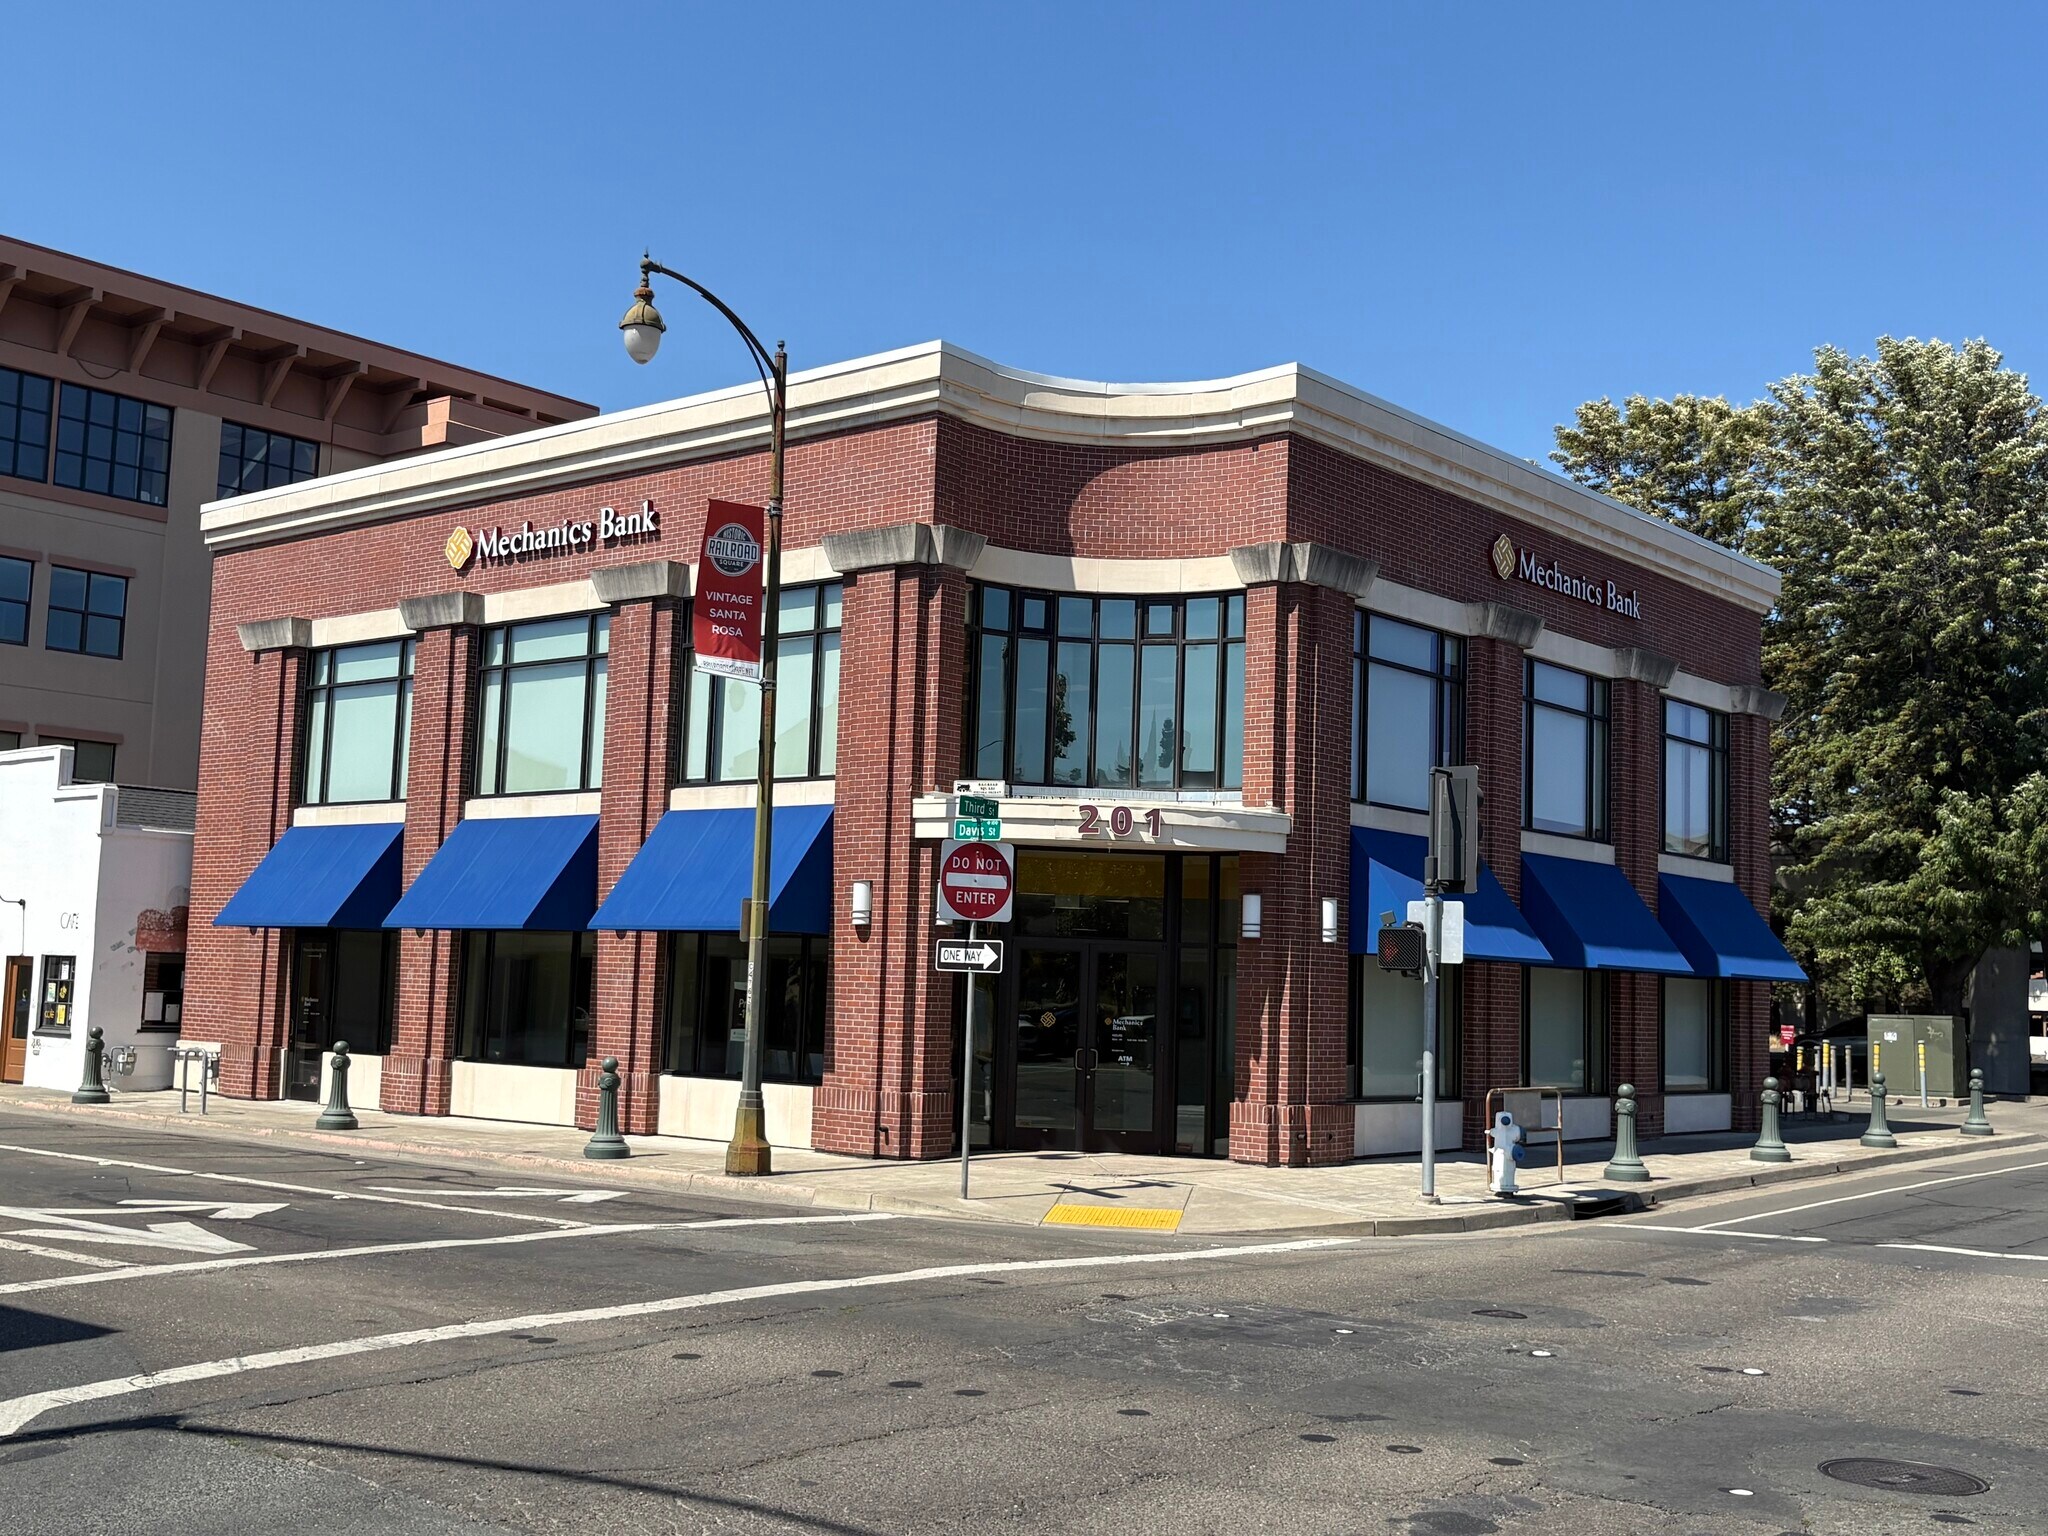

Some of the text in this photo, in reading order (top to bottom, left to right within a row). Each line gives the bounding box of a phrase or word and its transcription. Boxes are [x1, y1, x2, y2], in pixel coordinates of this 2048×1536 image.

[477, 500, 657, 559] Mechanics Bank
[722, 527, 746, 541] HISTORIC
[708, 540, 757, 560] RAILROAD
[719, 559, 744, 567] SQUARE
[1518, 548, 1641, 620] Mechanics Bank
[705, 590, 753, 605] VINTAGE
[709, 608, 747, 621] SANTA
[711, 624, 743, 637] ROSA
[965, 800, 995, 816] Third St
[1078, 804, 1161, 838] 201
[959, 824, 996, 836] Davis St
[952, 856, 1002, 872] DO NOT
[956, 891, 996, 905] ENTER
[943, 949, 982, 962] ONE WAY
[1112, 1018, 1144, 1026] Mechanics
